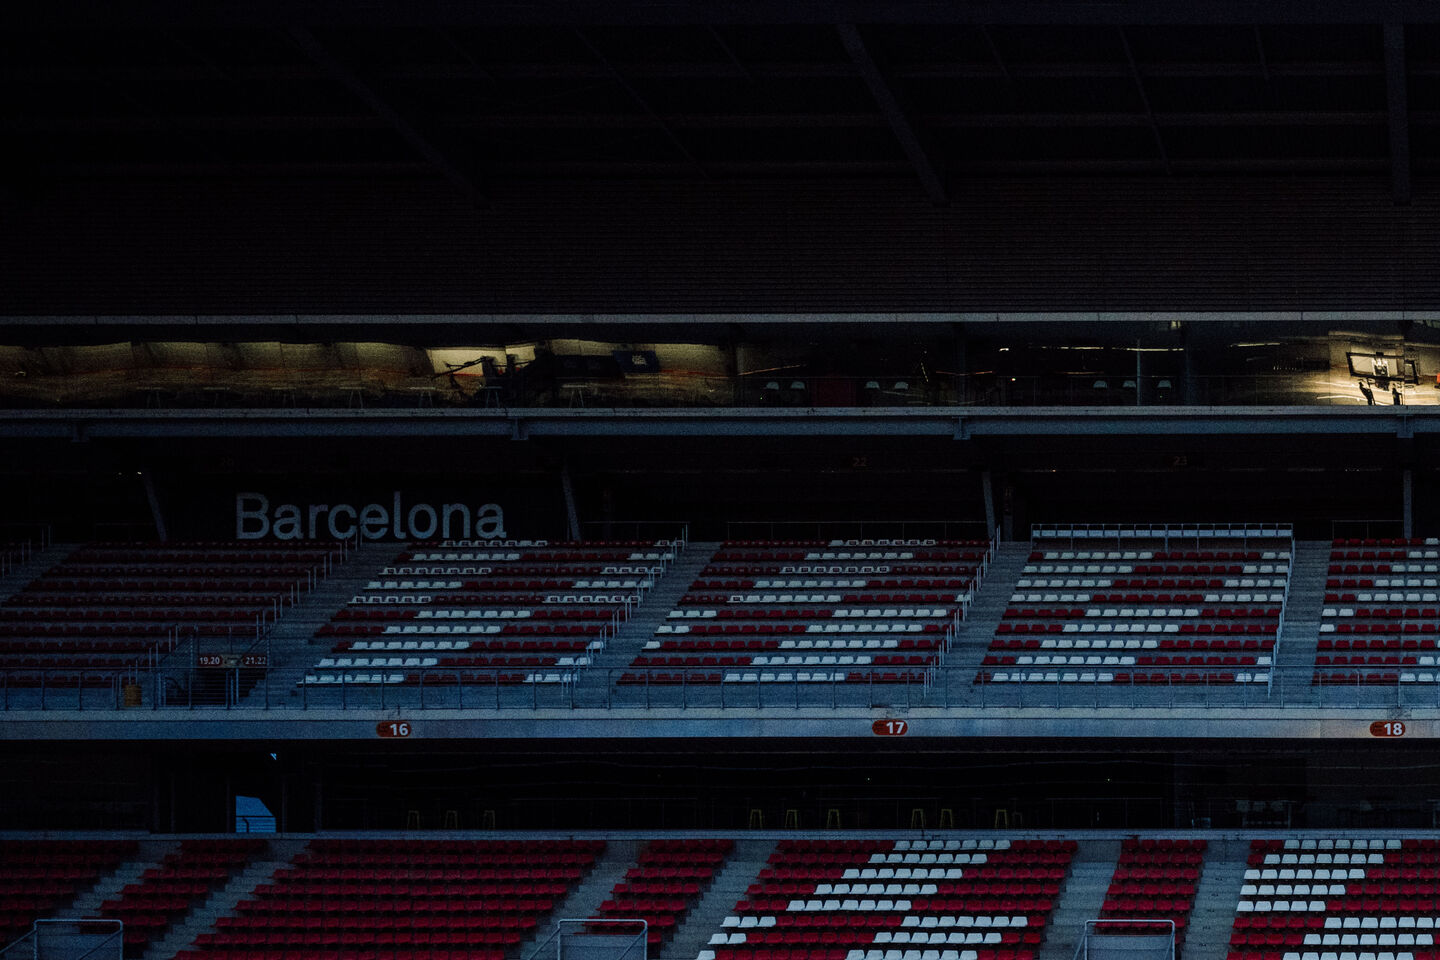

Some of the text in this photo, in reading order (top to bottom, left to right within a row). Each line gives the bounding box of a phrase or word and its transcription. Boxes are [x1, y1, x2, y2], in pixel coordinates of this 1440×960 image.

[236, 490, 507, 541] Barcelona
[199, 656, 220, 665] 19.20
[389, 723, 409, 736] 16
[886, 721, 905, 734] 17
[1383, 722, 1403, 736] 18
